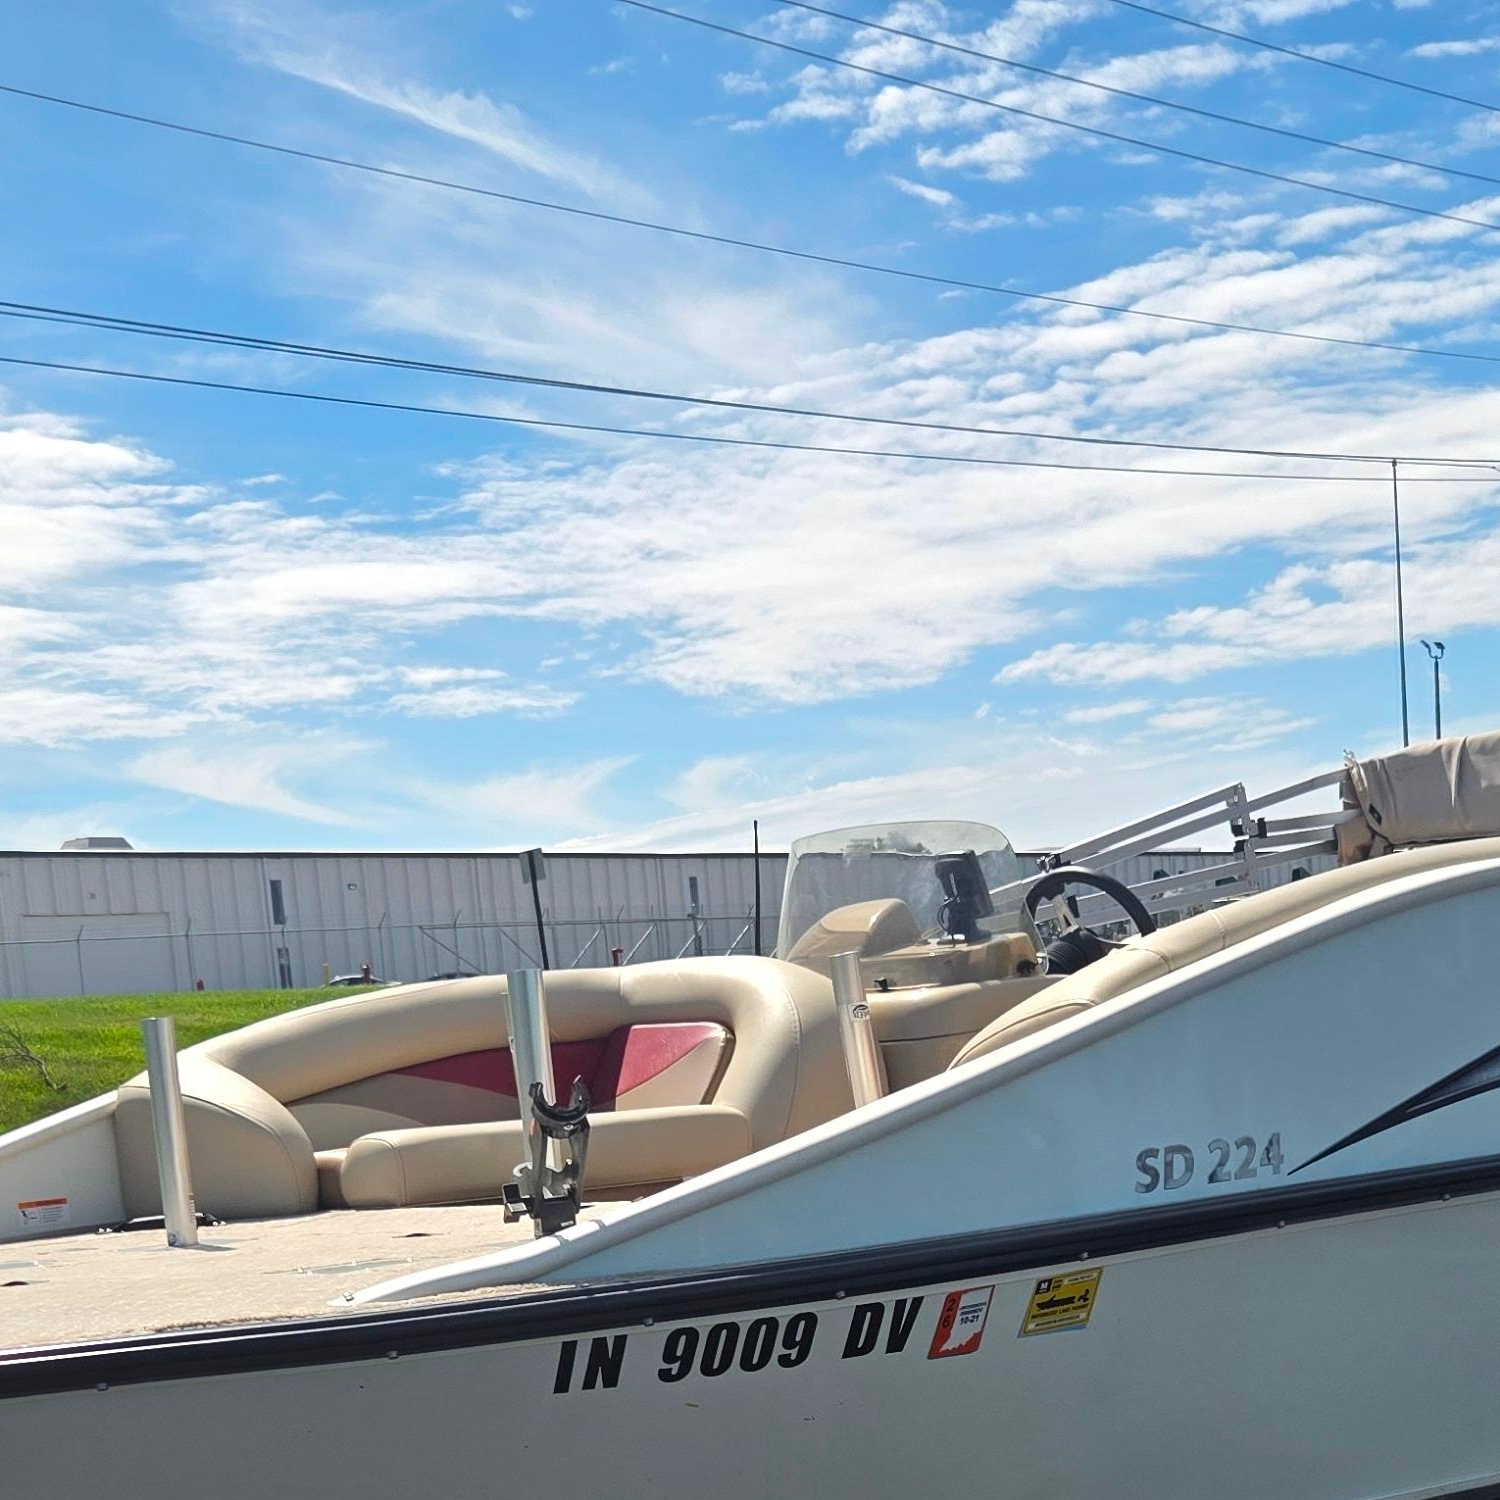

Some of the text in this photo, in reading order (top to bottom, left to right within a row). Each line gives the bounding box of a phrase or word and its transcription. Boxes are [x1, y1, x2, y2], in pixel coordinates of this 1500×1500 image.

[1134, 1132, 1285, 1194] SD 224
[552, 1296, 926, 1394] IN 9009 DV
